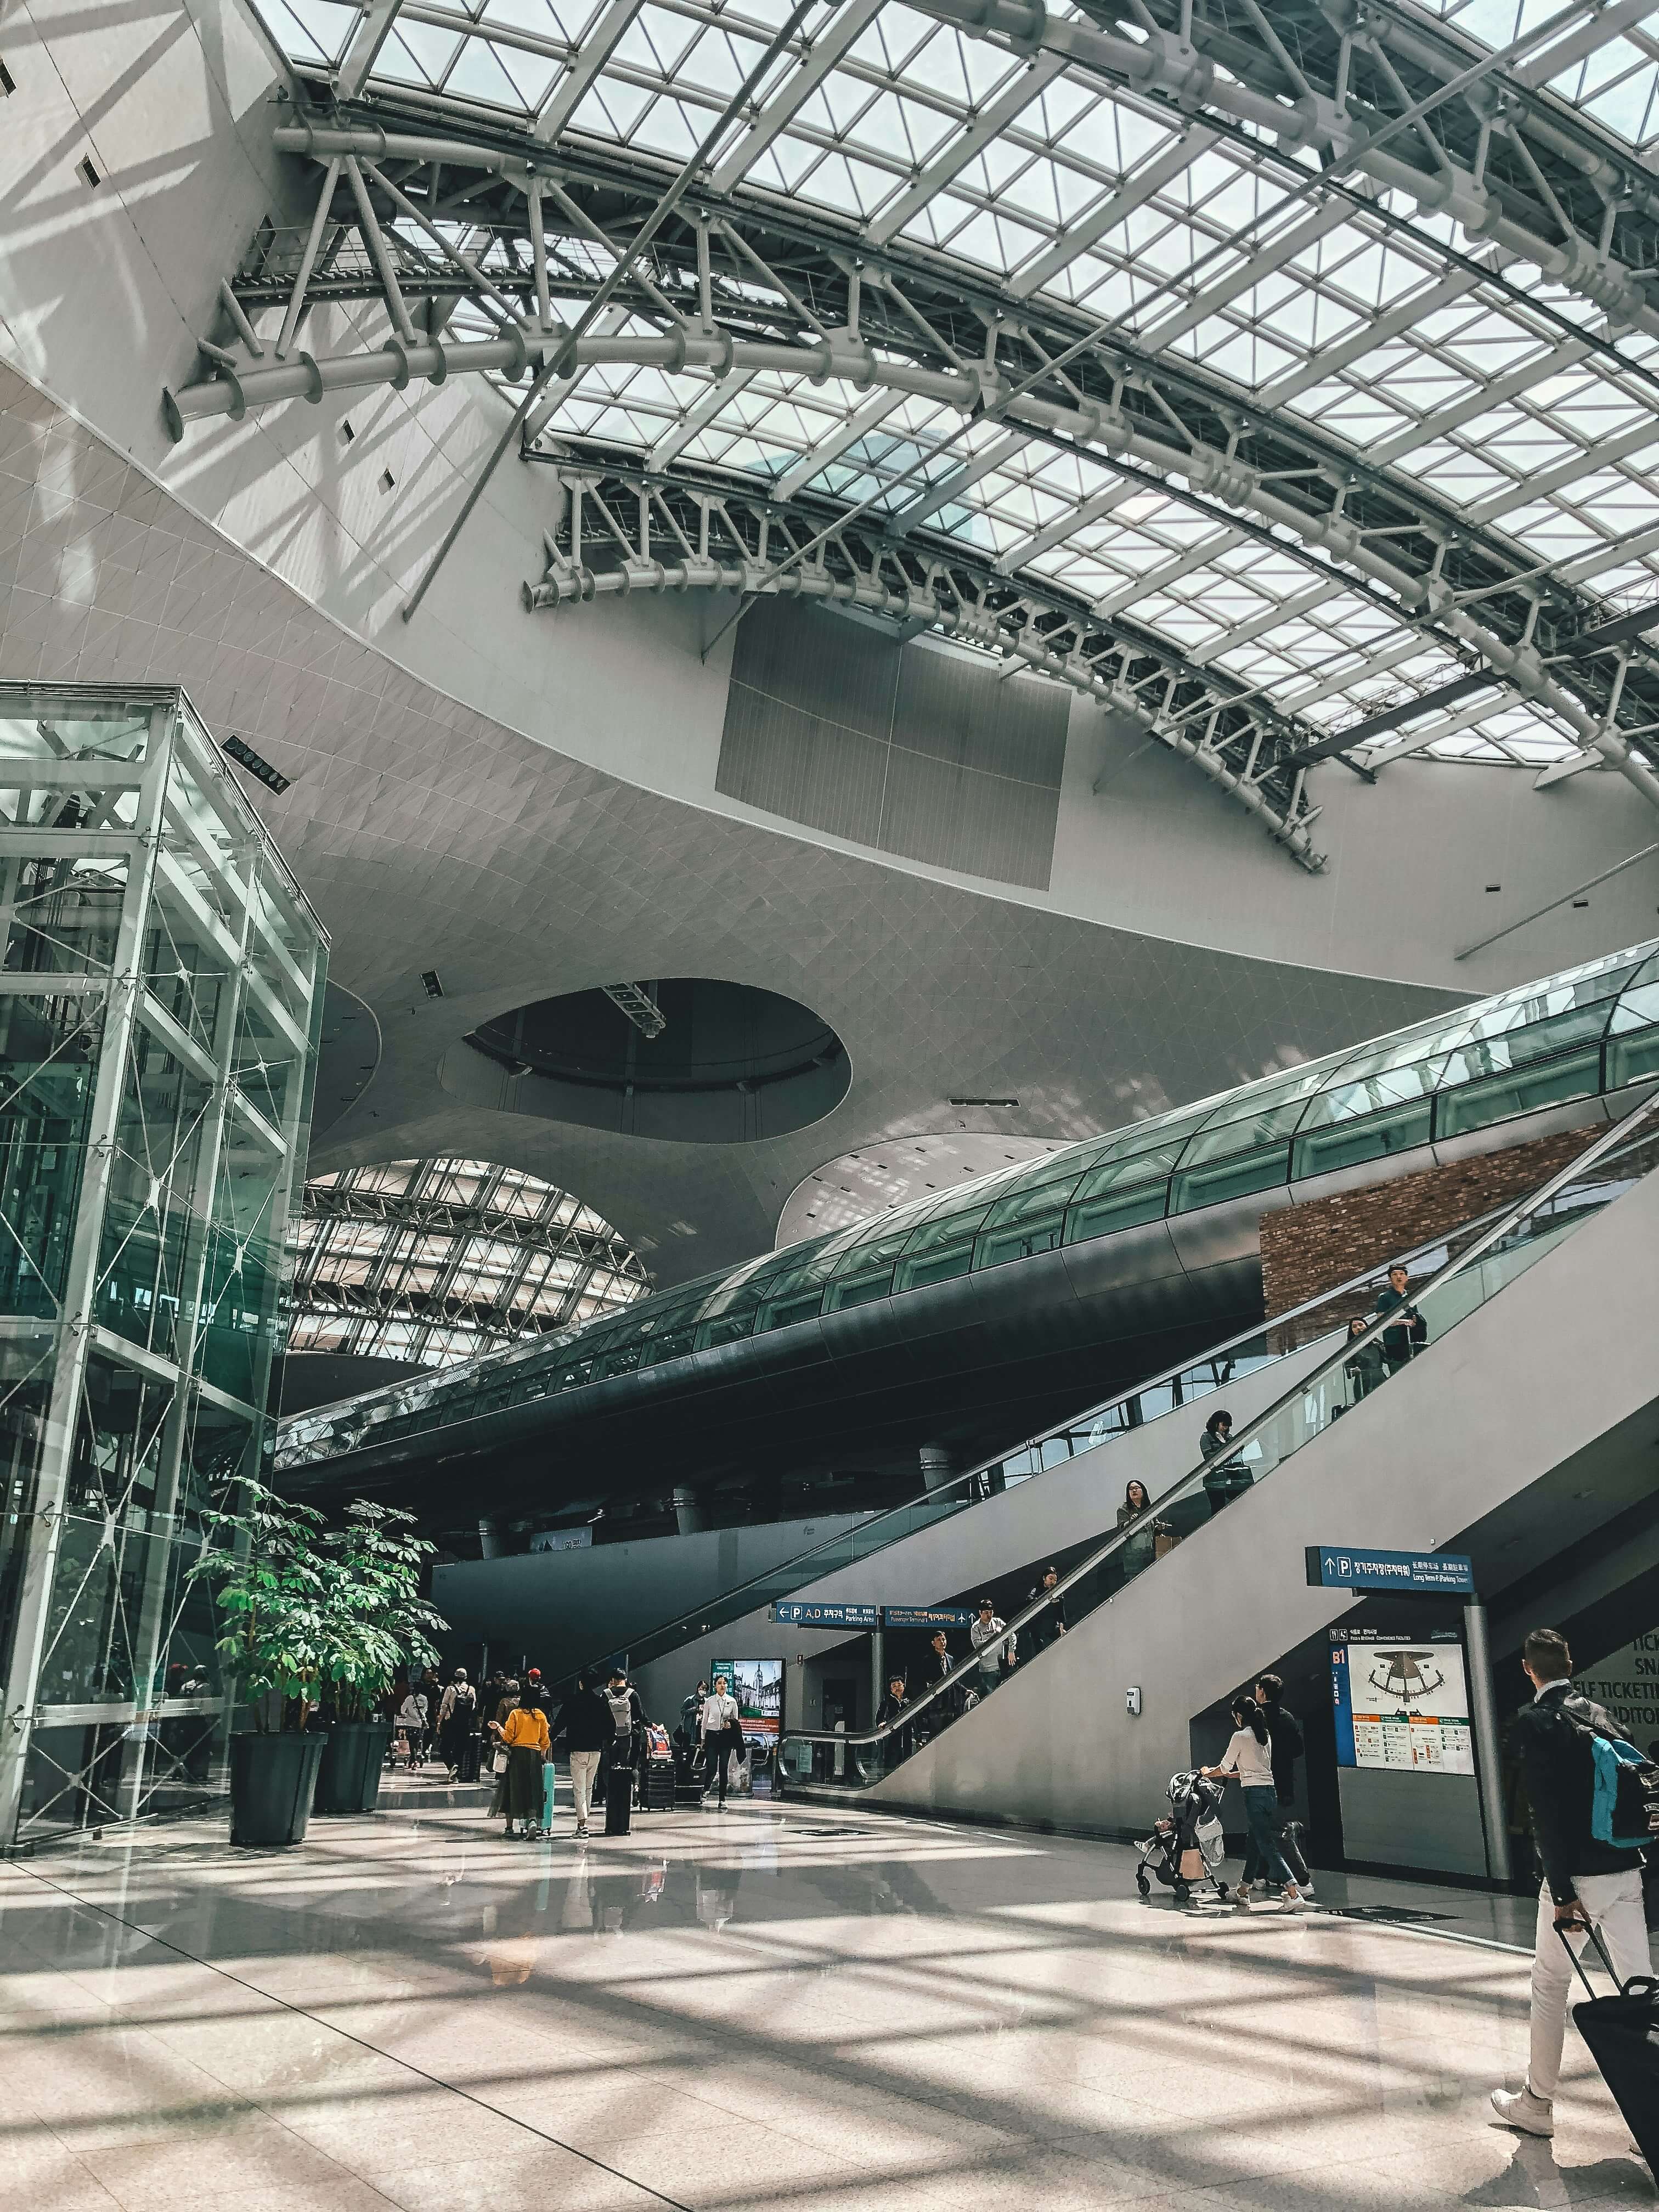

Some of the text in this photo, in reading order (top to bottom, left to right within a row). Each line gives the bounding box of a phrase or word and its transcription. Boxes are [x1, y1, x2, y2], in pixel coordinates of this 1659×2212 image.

[1341, 1560, 1349, 1574] P
[1413, 1574, 1424, 1582] Long
[793, 1607, 800, 1618] P
[1333, 1649, 1345, 1664] B1
[1635, 1658, 1659, 1675] SN
[1572, 1681, 1596, 1697] ELF
